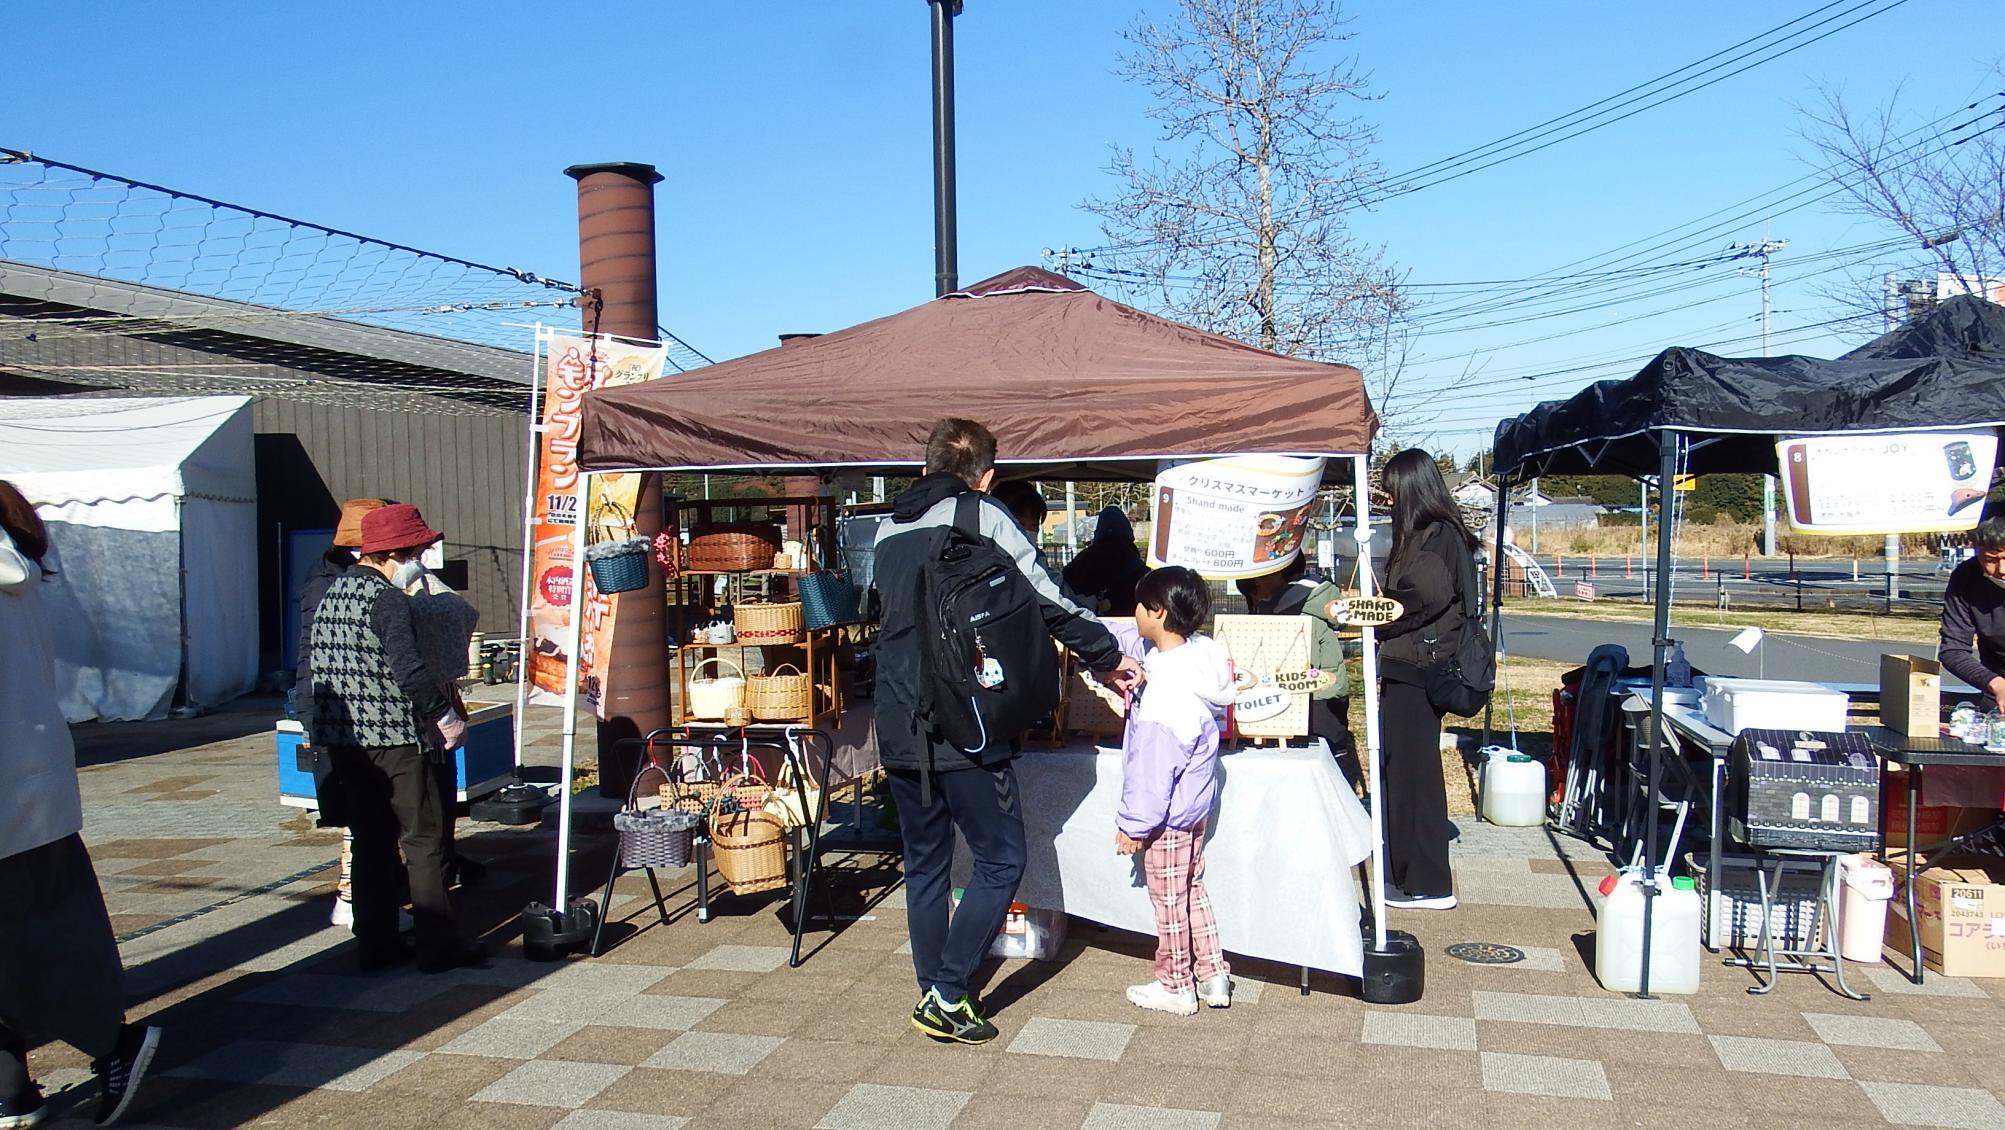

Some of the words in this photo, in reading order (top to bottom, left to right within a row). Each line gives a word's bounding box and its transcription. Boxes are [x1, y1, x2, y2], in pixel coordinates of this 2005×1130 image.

[1882, 443, 1908, 454] JOY
[1793, 452, 1802, 463] 8
[1188, 475, 1305, 500] クリスマスマーケット
[1162, 493, 1170, 503] 9
[1218, 501, 1245, 513] made
[1204, 549, 1235, 559] 600円
[1213, 559, 1244, 568] 800円
[1348, 600, 1395, 611] SHAND
[1353, 611, 1394, 622] MADE
[1275, 671, 1308, 682] KIDS
[1278, 680, 1318, 691] ROOM
[1235, 694, 1282, 711] TOILET
